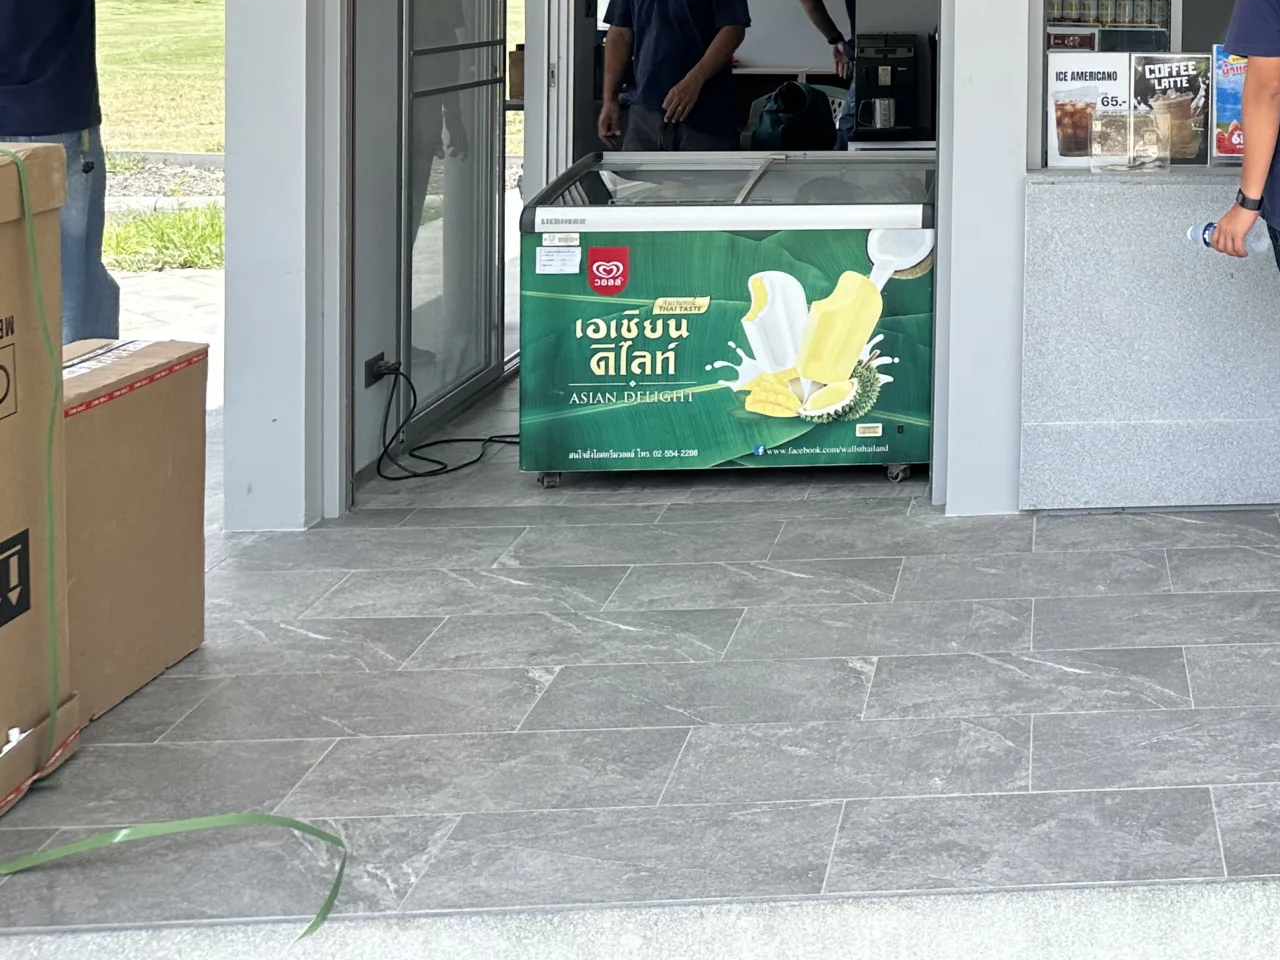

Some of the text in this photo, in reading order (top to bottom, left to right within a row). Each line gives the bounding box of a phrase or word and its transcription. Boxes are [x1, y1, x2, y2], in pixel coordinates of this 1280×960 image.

[1055, 70, 1118, 82] ICE AMERICANO
[1144, 61, 1198, 79] COFFEE
[1154, 76, 1189, 90] LATTE
[1101, 96, 1127, 107] 65.-
[575, 309, 690, 339] เอเชียน
[589, 340, 681, 376] ดีไลท์
[568, 390, 695, 404] ASIAN DELIGHT
[766, 444, 889, 455] www.facebook.com/wallsthailand
